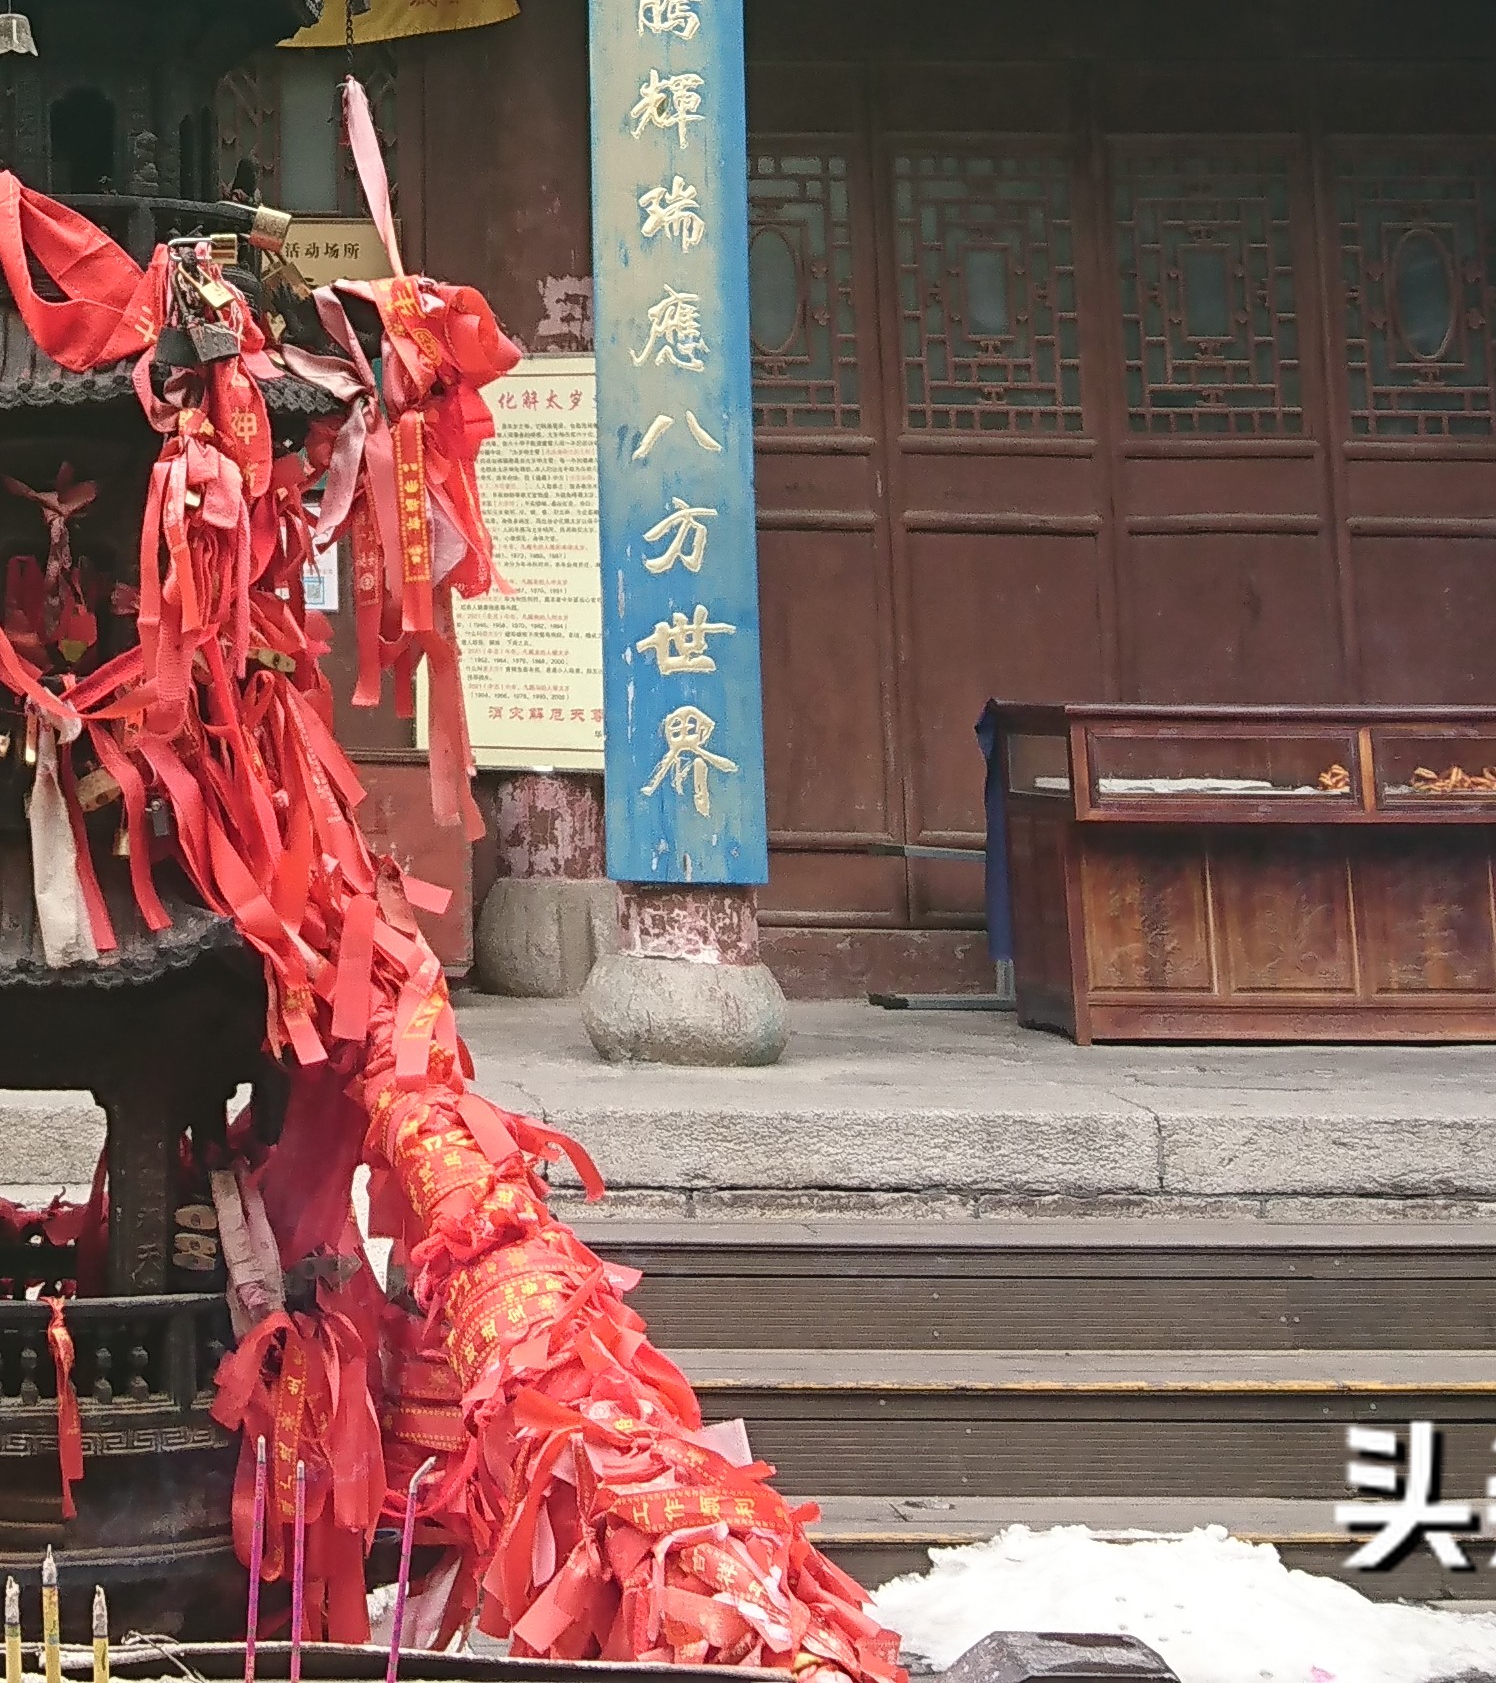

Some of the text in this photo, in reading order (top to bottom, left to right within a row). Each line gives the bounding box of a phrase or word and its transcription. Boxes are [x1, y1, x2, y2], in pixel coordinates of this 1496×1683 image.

[285, 241, 361, 260] 活动场所
[498, 388, 597, 412] 化解太岁
